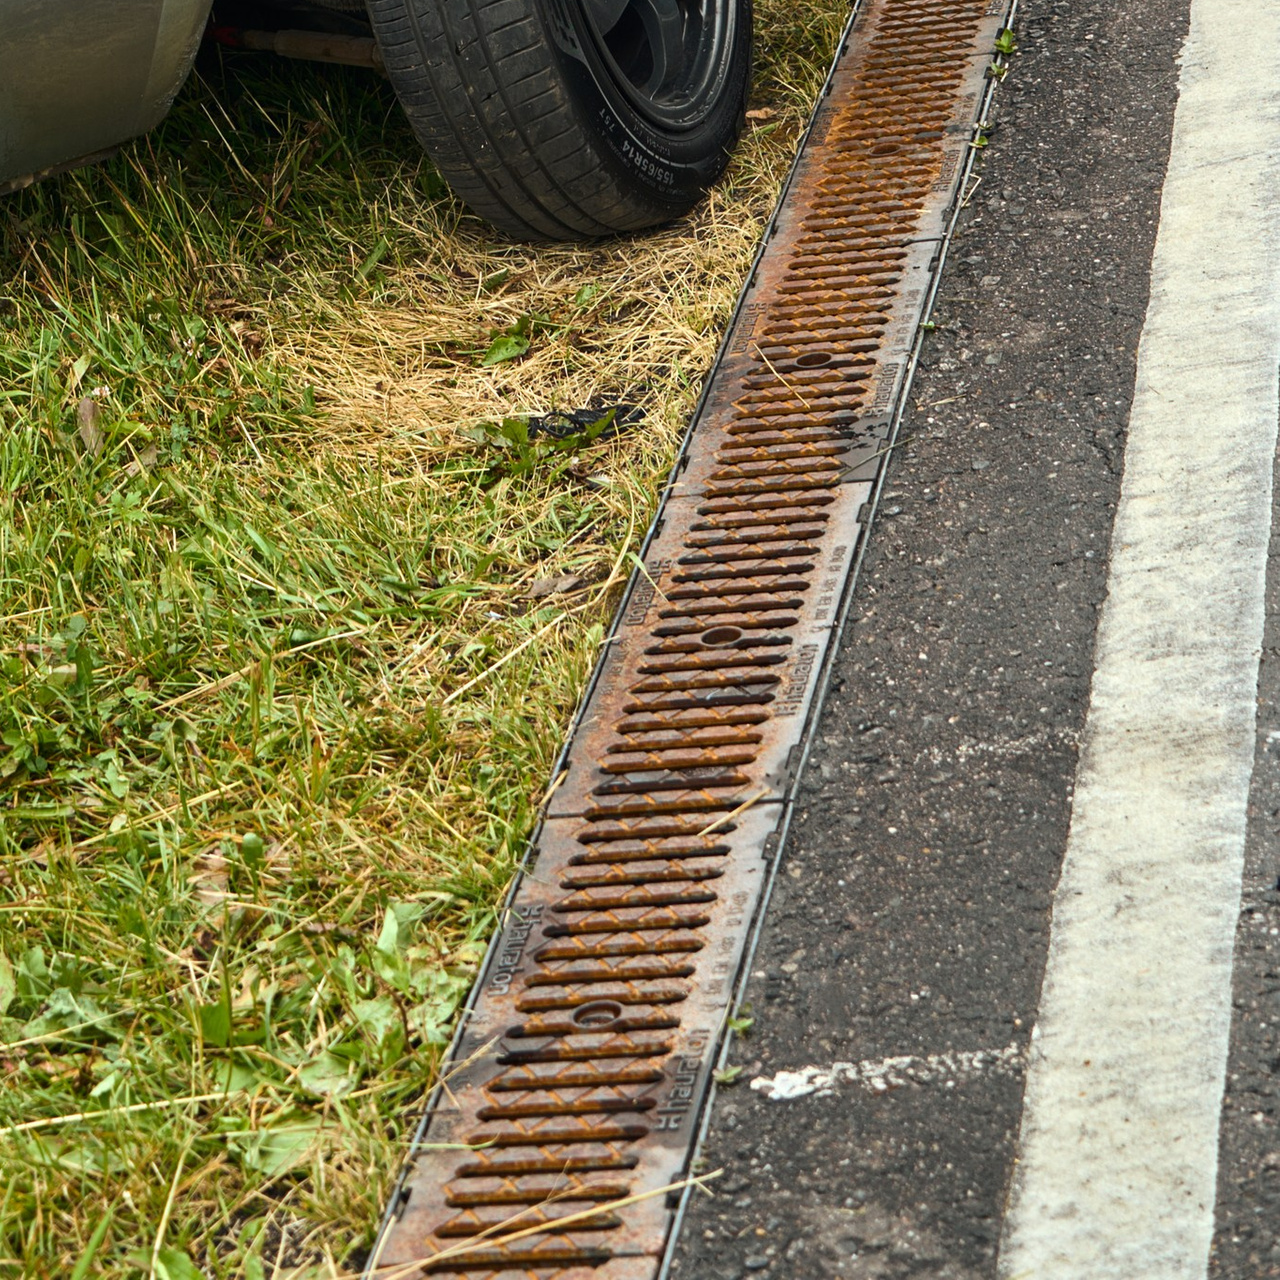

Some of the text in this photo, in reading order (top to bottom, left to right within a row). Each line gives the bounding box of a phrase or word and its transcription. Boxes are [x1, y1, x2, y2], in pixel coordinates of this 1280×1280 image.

[599, 108, 616, 132] 75T
[622, 140, 674, 186] 155/65R14
[487, 920, 542, 997] hauraton
[656, 1027, 710, 1113] hauraton
